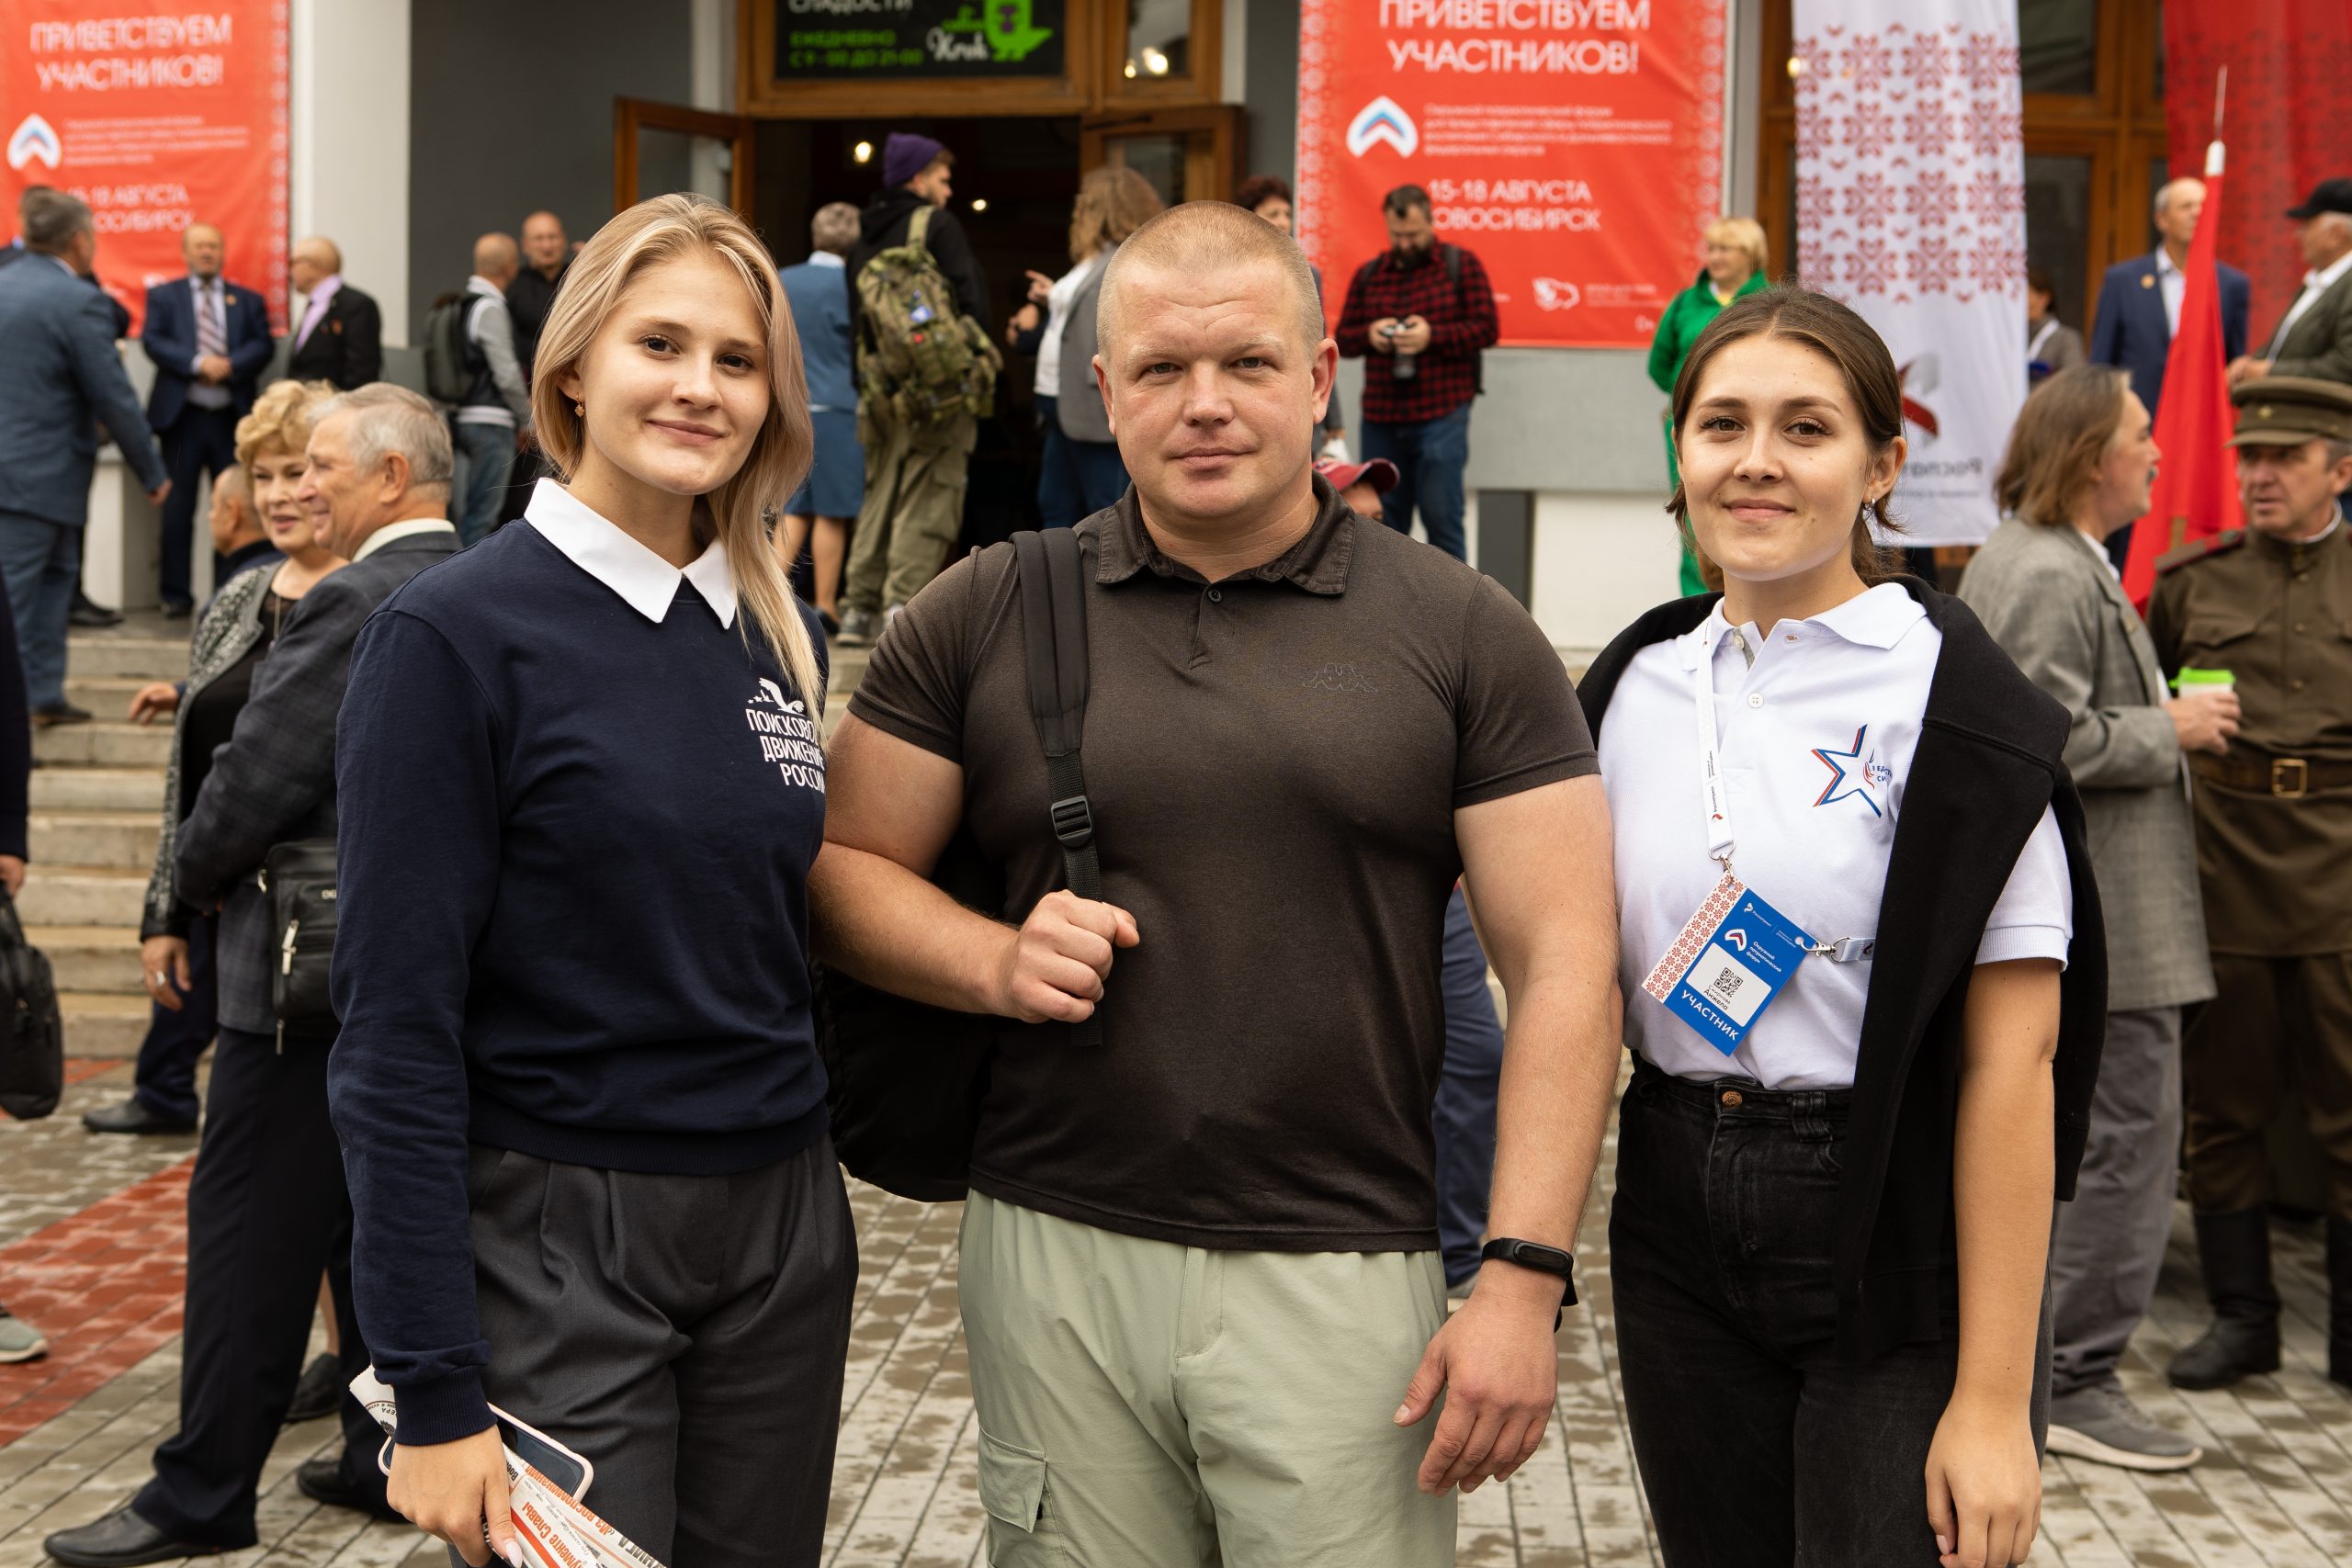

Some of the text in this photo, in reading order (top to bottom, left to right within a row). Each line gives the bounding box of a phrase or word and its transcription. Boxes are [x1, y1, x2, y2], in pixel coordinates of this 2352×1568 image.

[1378, 0, 1650, 29] ПРИВЕТСТВУЕМ
[28, 14, 232, 53] ПРИВЕТСТВУЕМ
[1385, 39, 1640, 73] УЧАСТНИКОВ!
[35, 53, 223, 91] УЧАСТНИКОВ!
[114, 184, 189, 207] АВГУСТА
[1490, 180, 1593, 204] АВГУСТА
[92, 209, 196, 232] ОСИБИРСК
[1432, 207, 1601, 231] ОВОСИБИРСК
[1681, 989, 1739, 1041] УЧАСТНИК
[521, 1501, 552, 1540] Славы
